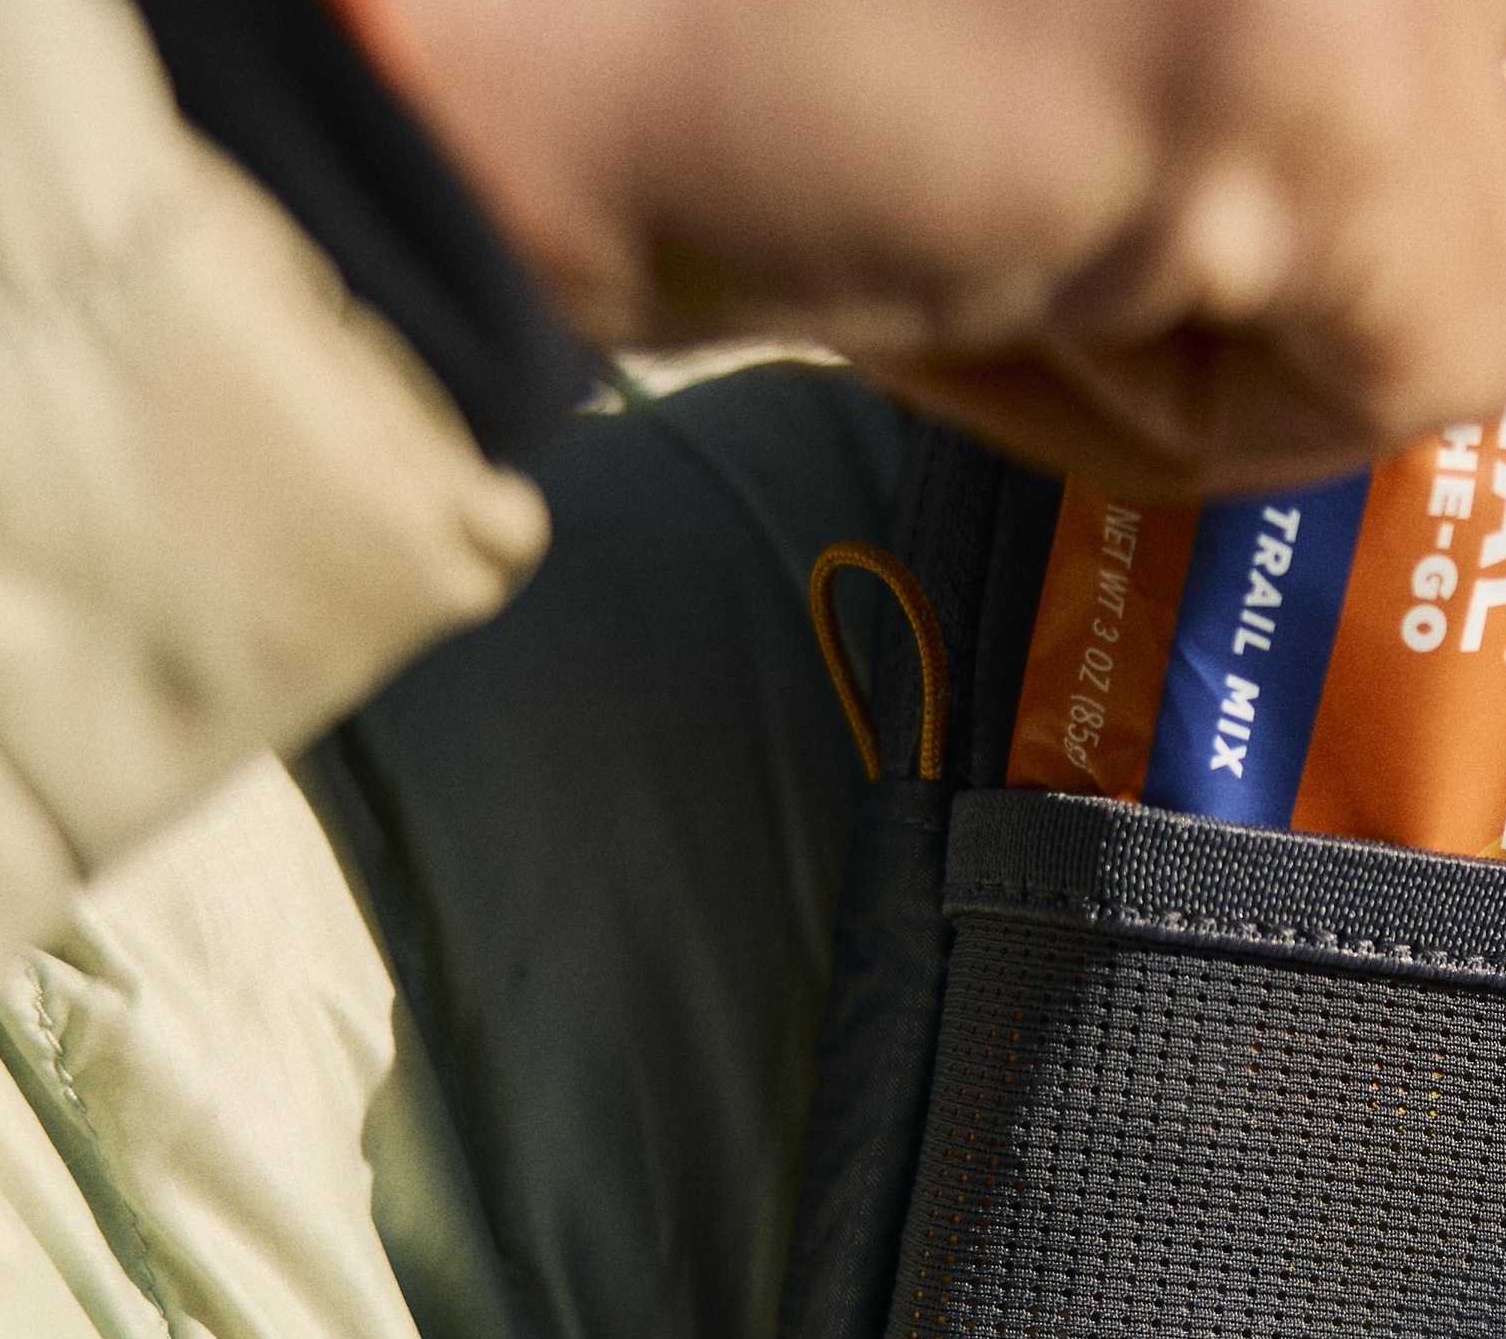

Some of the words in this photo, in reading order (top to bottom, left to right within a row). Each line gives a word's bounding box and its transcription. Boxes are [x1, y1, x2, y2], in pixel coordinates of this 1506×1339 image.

[1101, 504, 1142, 570] NET
[1401, 422, 1484, 653] HE-GO
[1097, 569, 1129, 619] WT
[1232, 506, 1301, 656] TRAIL
[1093, 619, 1119, 644] 3
[1078, 647, 1115, 694] OZ
[1209, 673, 1261, 780] MIX
